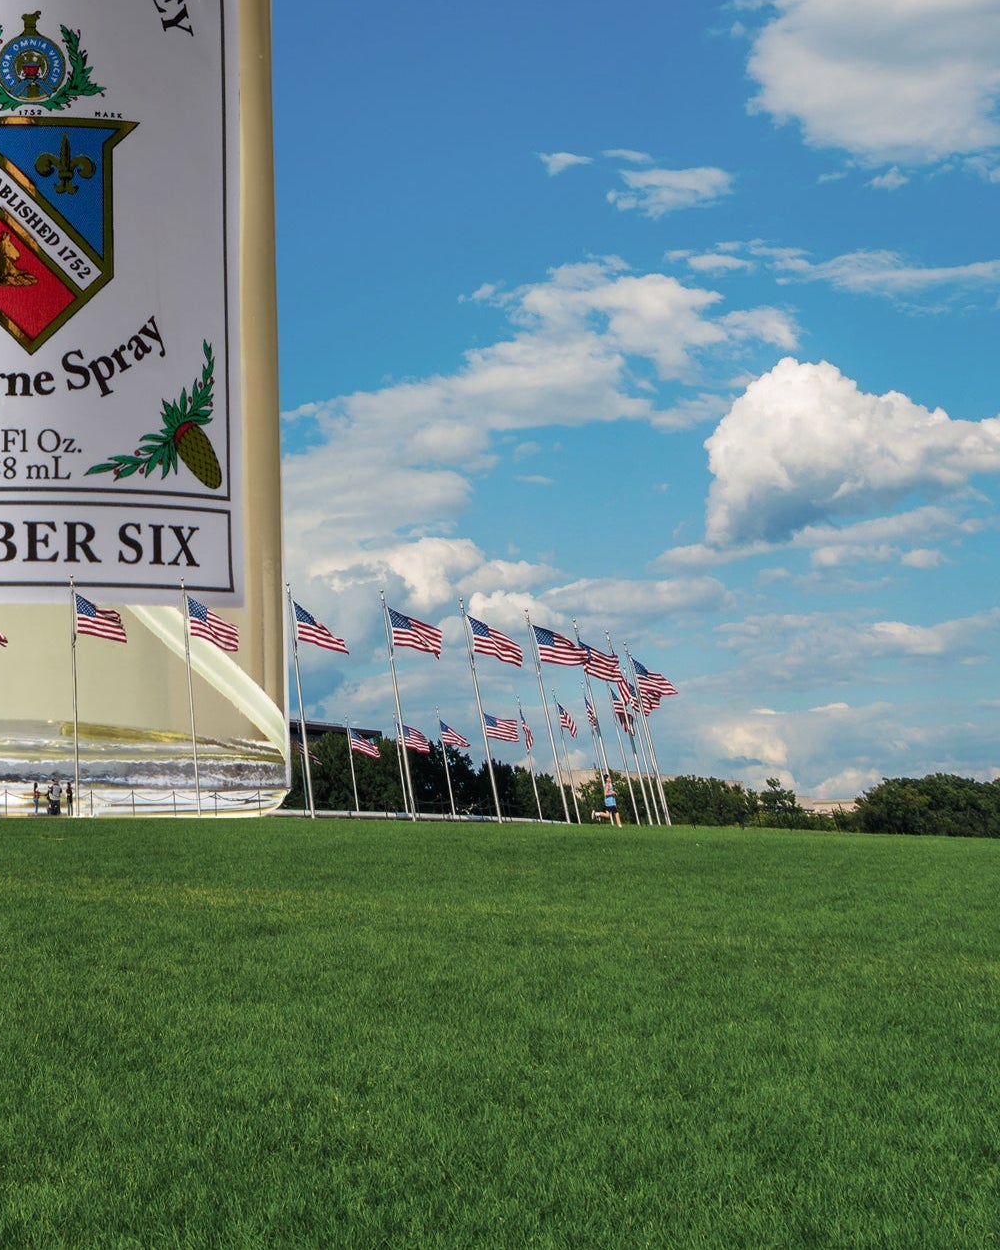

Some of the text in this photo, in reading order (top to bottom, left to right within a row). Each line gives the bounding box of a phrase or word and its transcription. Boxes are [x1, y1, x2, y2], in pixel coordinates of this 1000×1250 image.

[1, 39, 62, 86] LABOR OMNIA VINCIT
[94, 111, 124, 119] MARK
[57, 246, 91, 280] 1752
[61, 315, 167, 398] Spray
[1, 429, 28, 453] Fl
[37, 430, 82, 454] Oz.
[26, 455, 71, 481] mL
[118, 523, 201, 568] SIX
